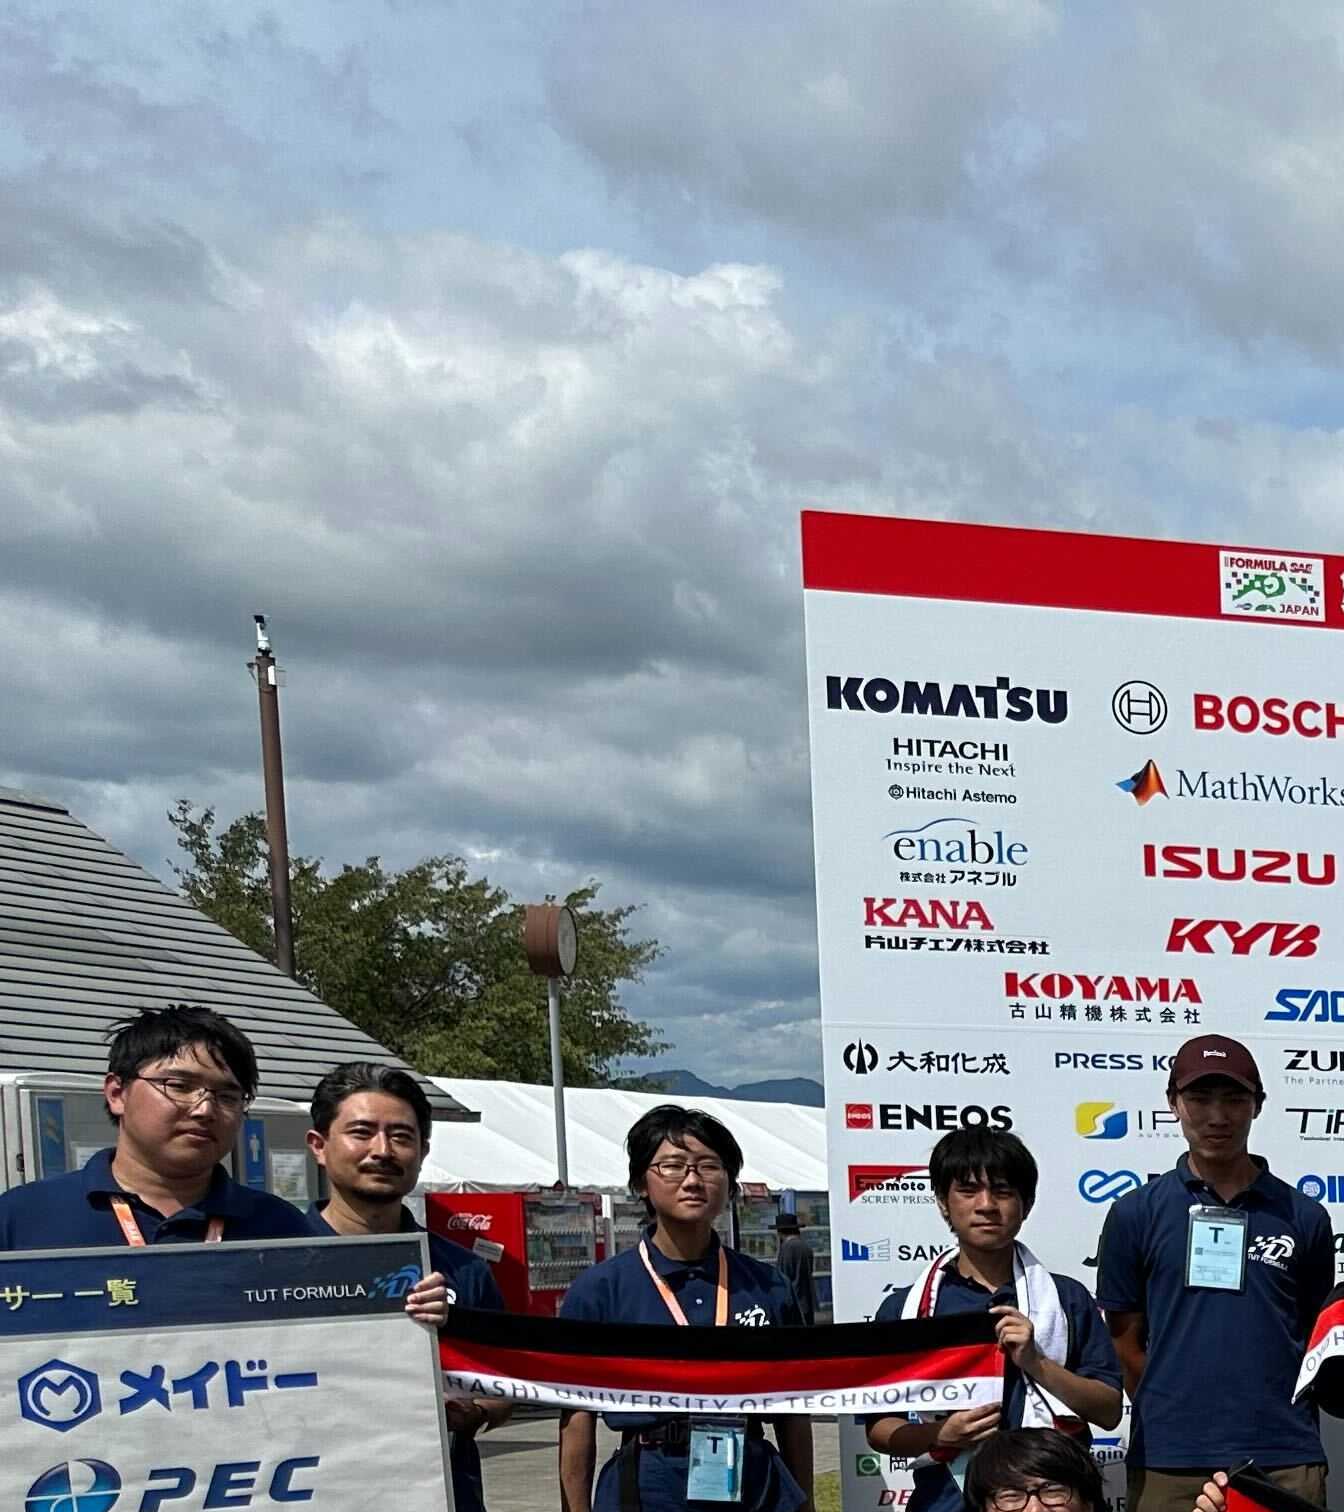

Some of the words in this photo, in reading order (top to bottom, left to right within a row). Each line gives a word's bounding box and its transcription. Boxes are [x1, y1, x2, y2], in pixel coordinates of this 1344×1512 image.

[1279, 603, 1320, 616] JAPAN
[826, 675, 1069, 724] KOMATSU
[893, 738, 1009, 761] HITACHI
[885, 759, 943, 775] Inspire
[948, 762, 974, 777] the
[978, 763, 1017, 778] Next
[906, 786, 957, 802] Hitachi
[962, 788, 1018, 804] Astemo
[893, 829, 1029, 867] enable
[1143, 844, 1336, 886] ISUZU
[864, 897, 994, 931] KANA
[1166, 917, 1321, 958] KYB
[1004, 971, 1203, 1004] KOYAMA
[1009, 1003, 1202, 1025] 古山精機株式会社
[886, 1050, 1011, 1076] 大和化成
[1055, 1051, 1144, 1071] PRESS
[1284, 1076, 1304, 1086] The
[879, 1104, 1014, 1132] ENEOS
[1208, 1227, 1224, 1243] T
[244, 1288, 278, 1304] TUT
[282, 1283, 367, 1302] FORMULA
[119, 1358, 319, 1416] メイドー
[785, 1380, 980, 1411] TECHNOLOGY
